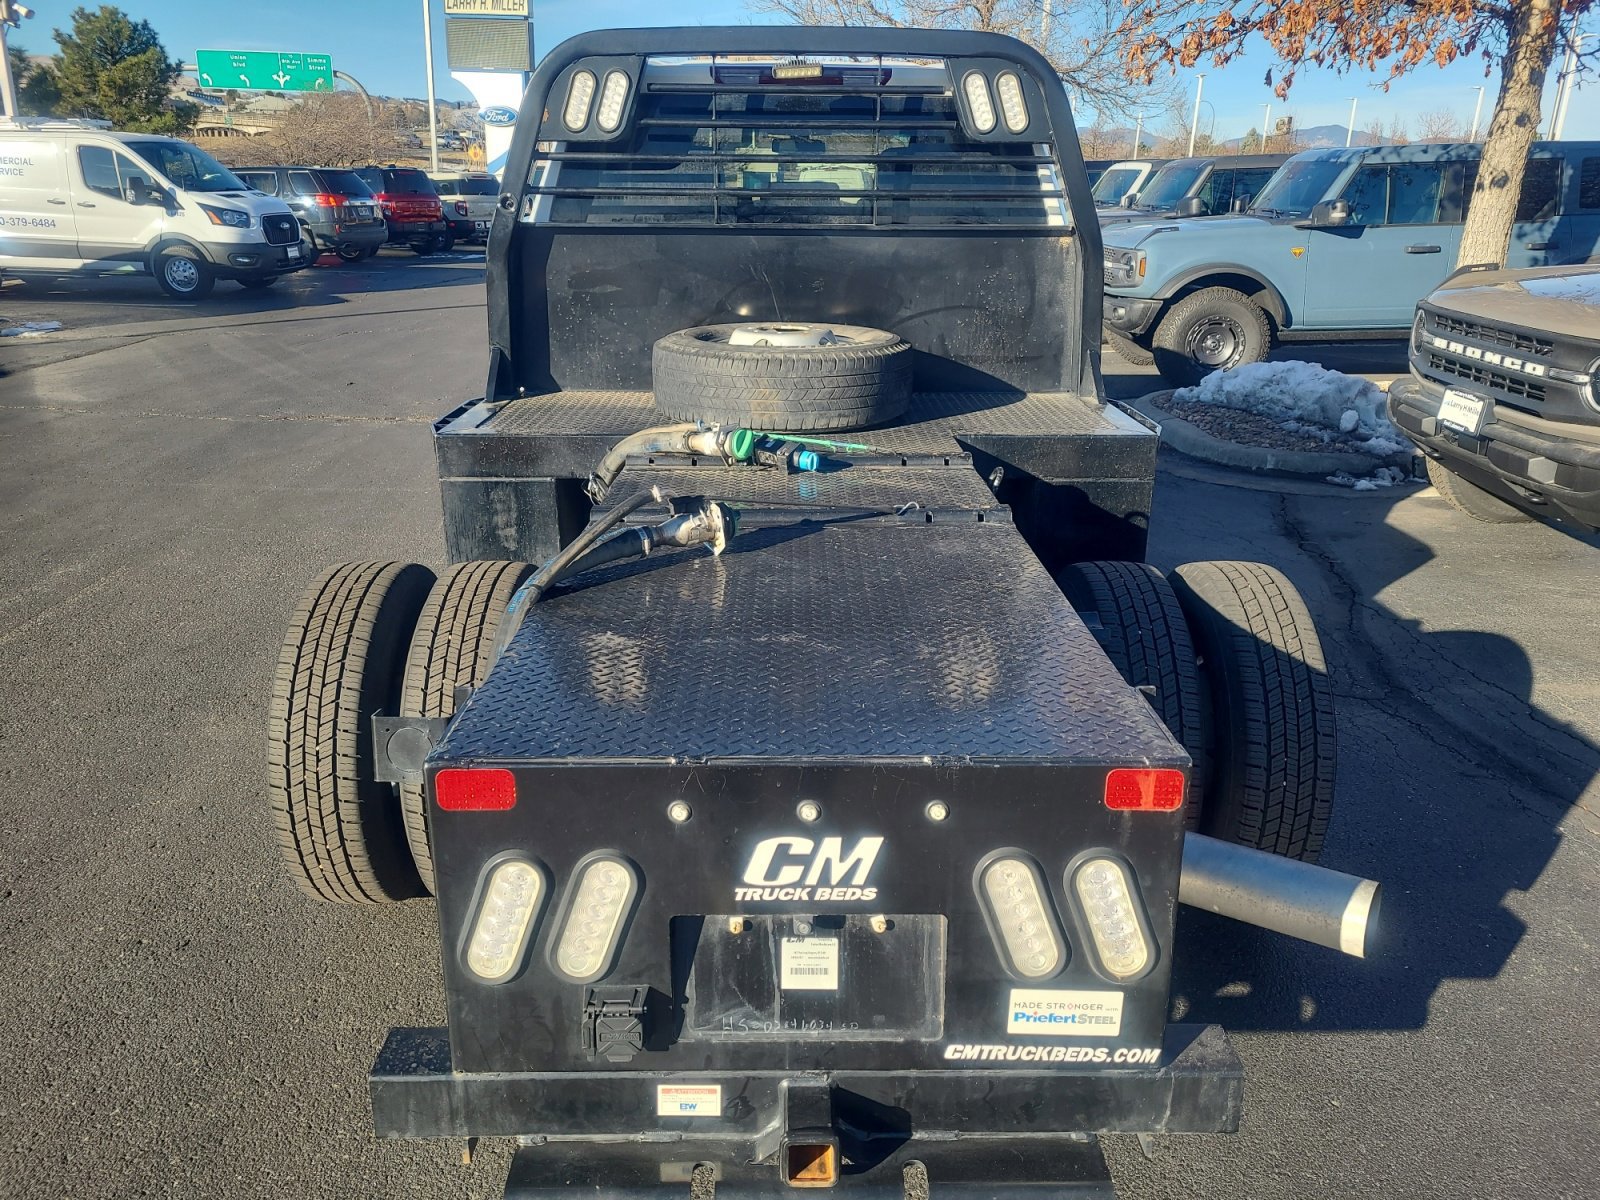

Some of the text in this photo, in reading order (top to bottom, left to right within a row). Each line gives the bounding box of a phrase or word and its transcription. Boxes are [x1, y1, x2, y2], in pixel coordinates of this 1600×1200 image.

[446, 0, 525, 11] LARRY H. MILLER
[484, 110, 510, 121] Ford
[1433, 337, 1545, 377] BRONCO
[743, 836, 884, 886] CM
[735, 887, 878, 901] TRUCK BEDS
[1014, 1001, 1043, 1010] MADE
[1046, 1002, 1104, 1011] STRONGER
[944, 1045, 1162, 1064] CMTRUCKBEDS.COM
